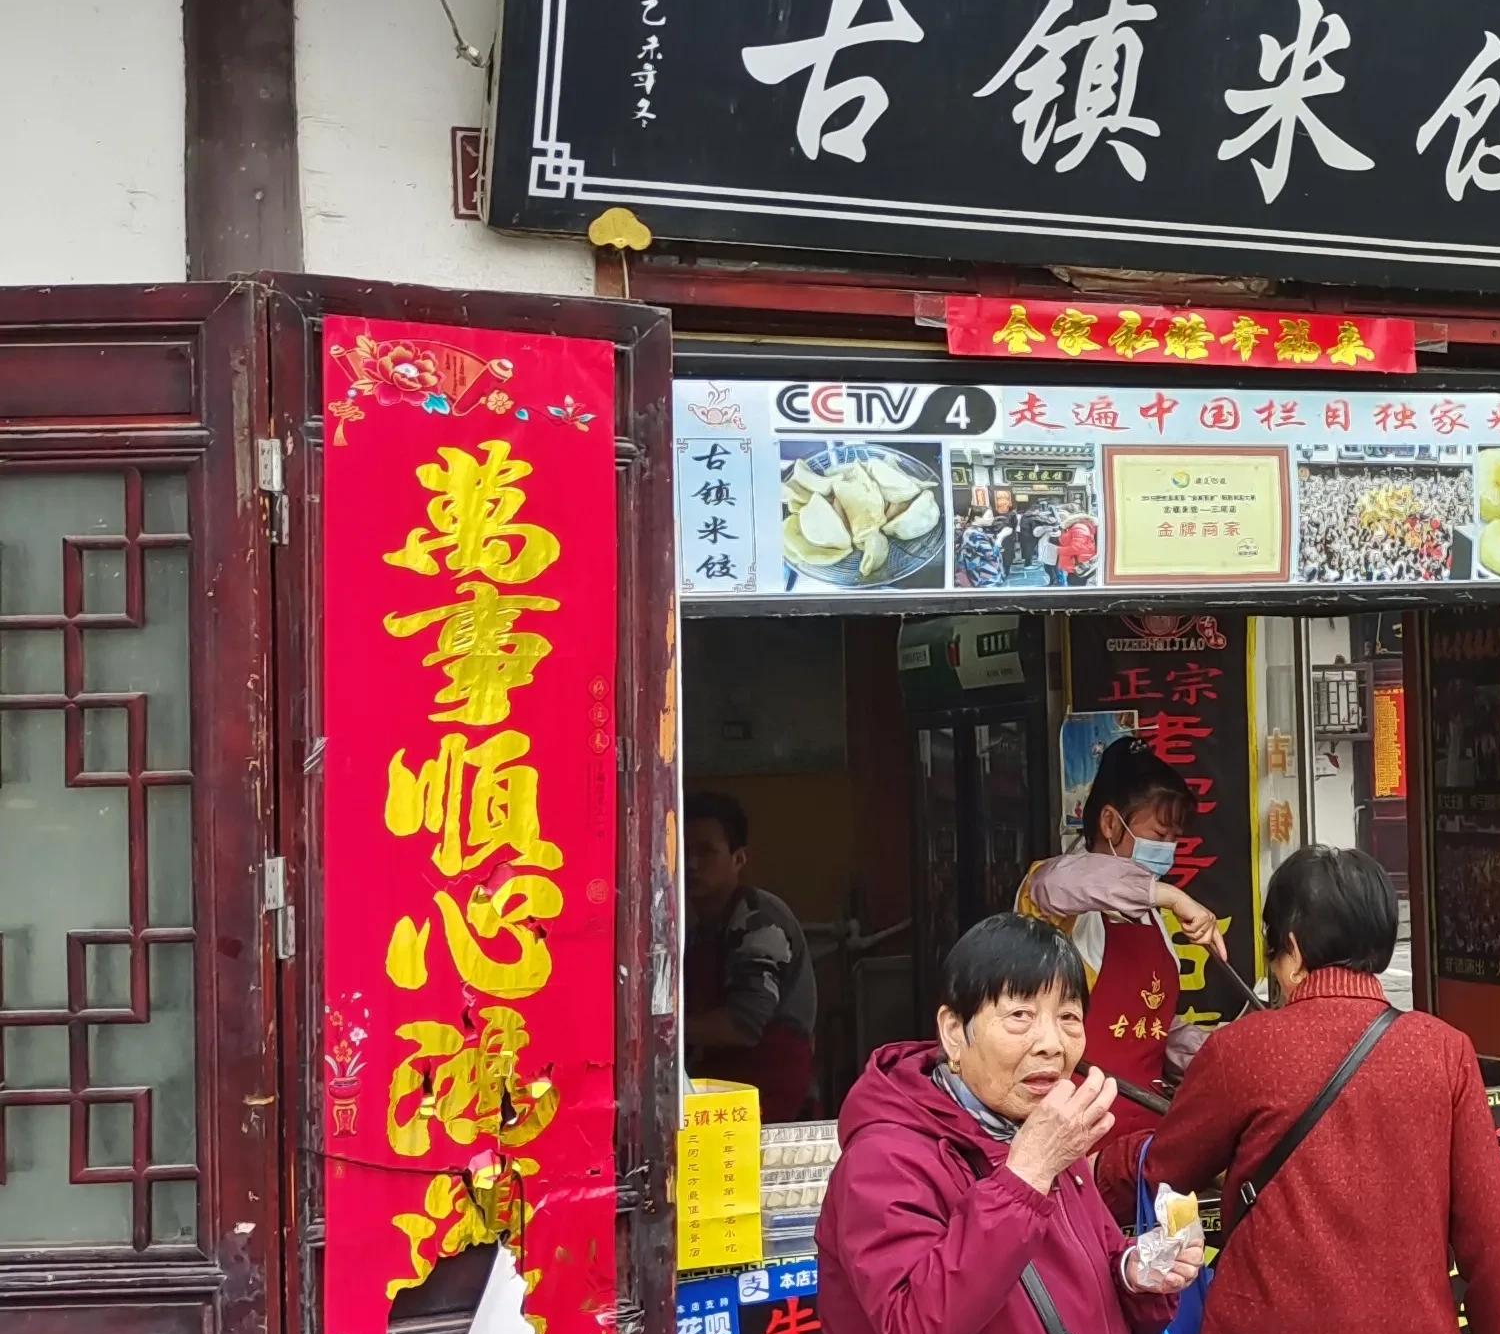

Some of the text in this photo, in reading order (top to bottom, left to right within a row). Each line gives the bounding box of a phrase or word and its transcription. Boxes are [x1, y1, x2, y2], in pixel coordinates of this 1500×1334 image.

[776, 384, 971, 430] CCTV 4
[691, 443, 739, 580] 古镇米饺
[1157, 521, 1241, 538] 金牌商家
